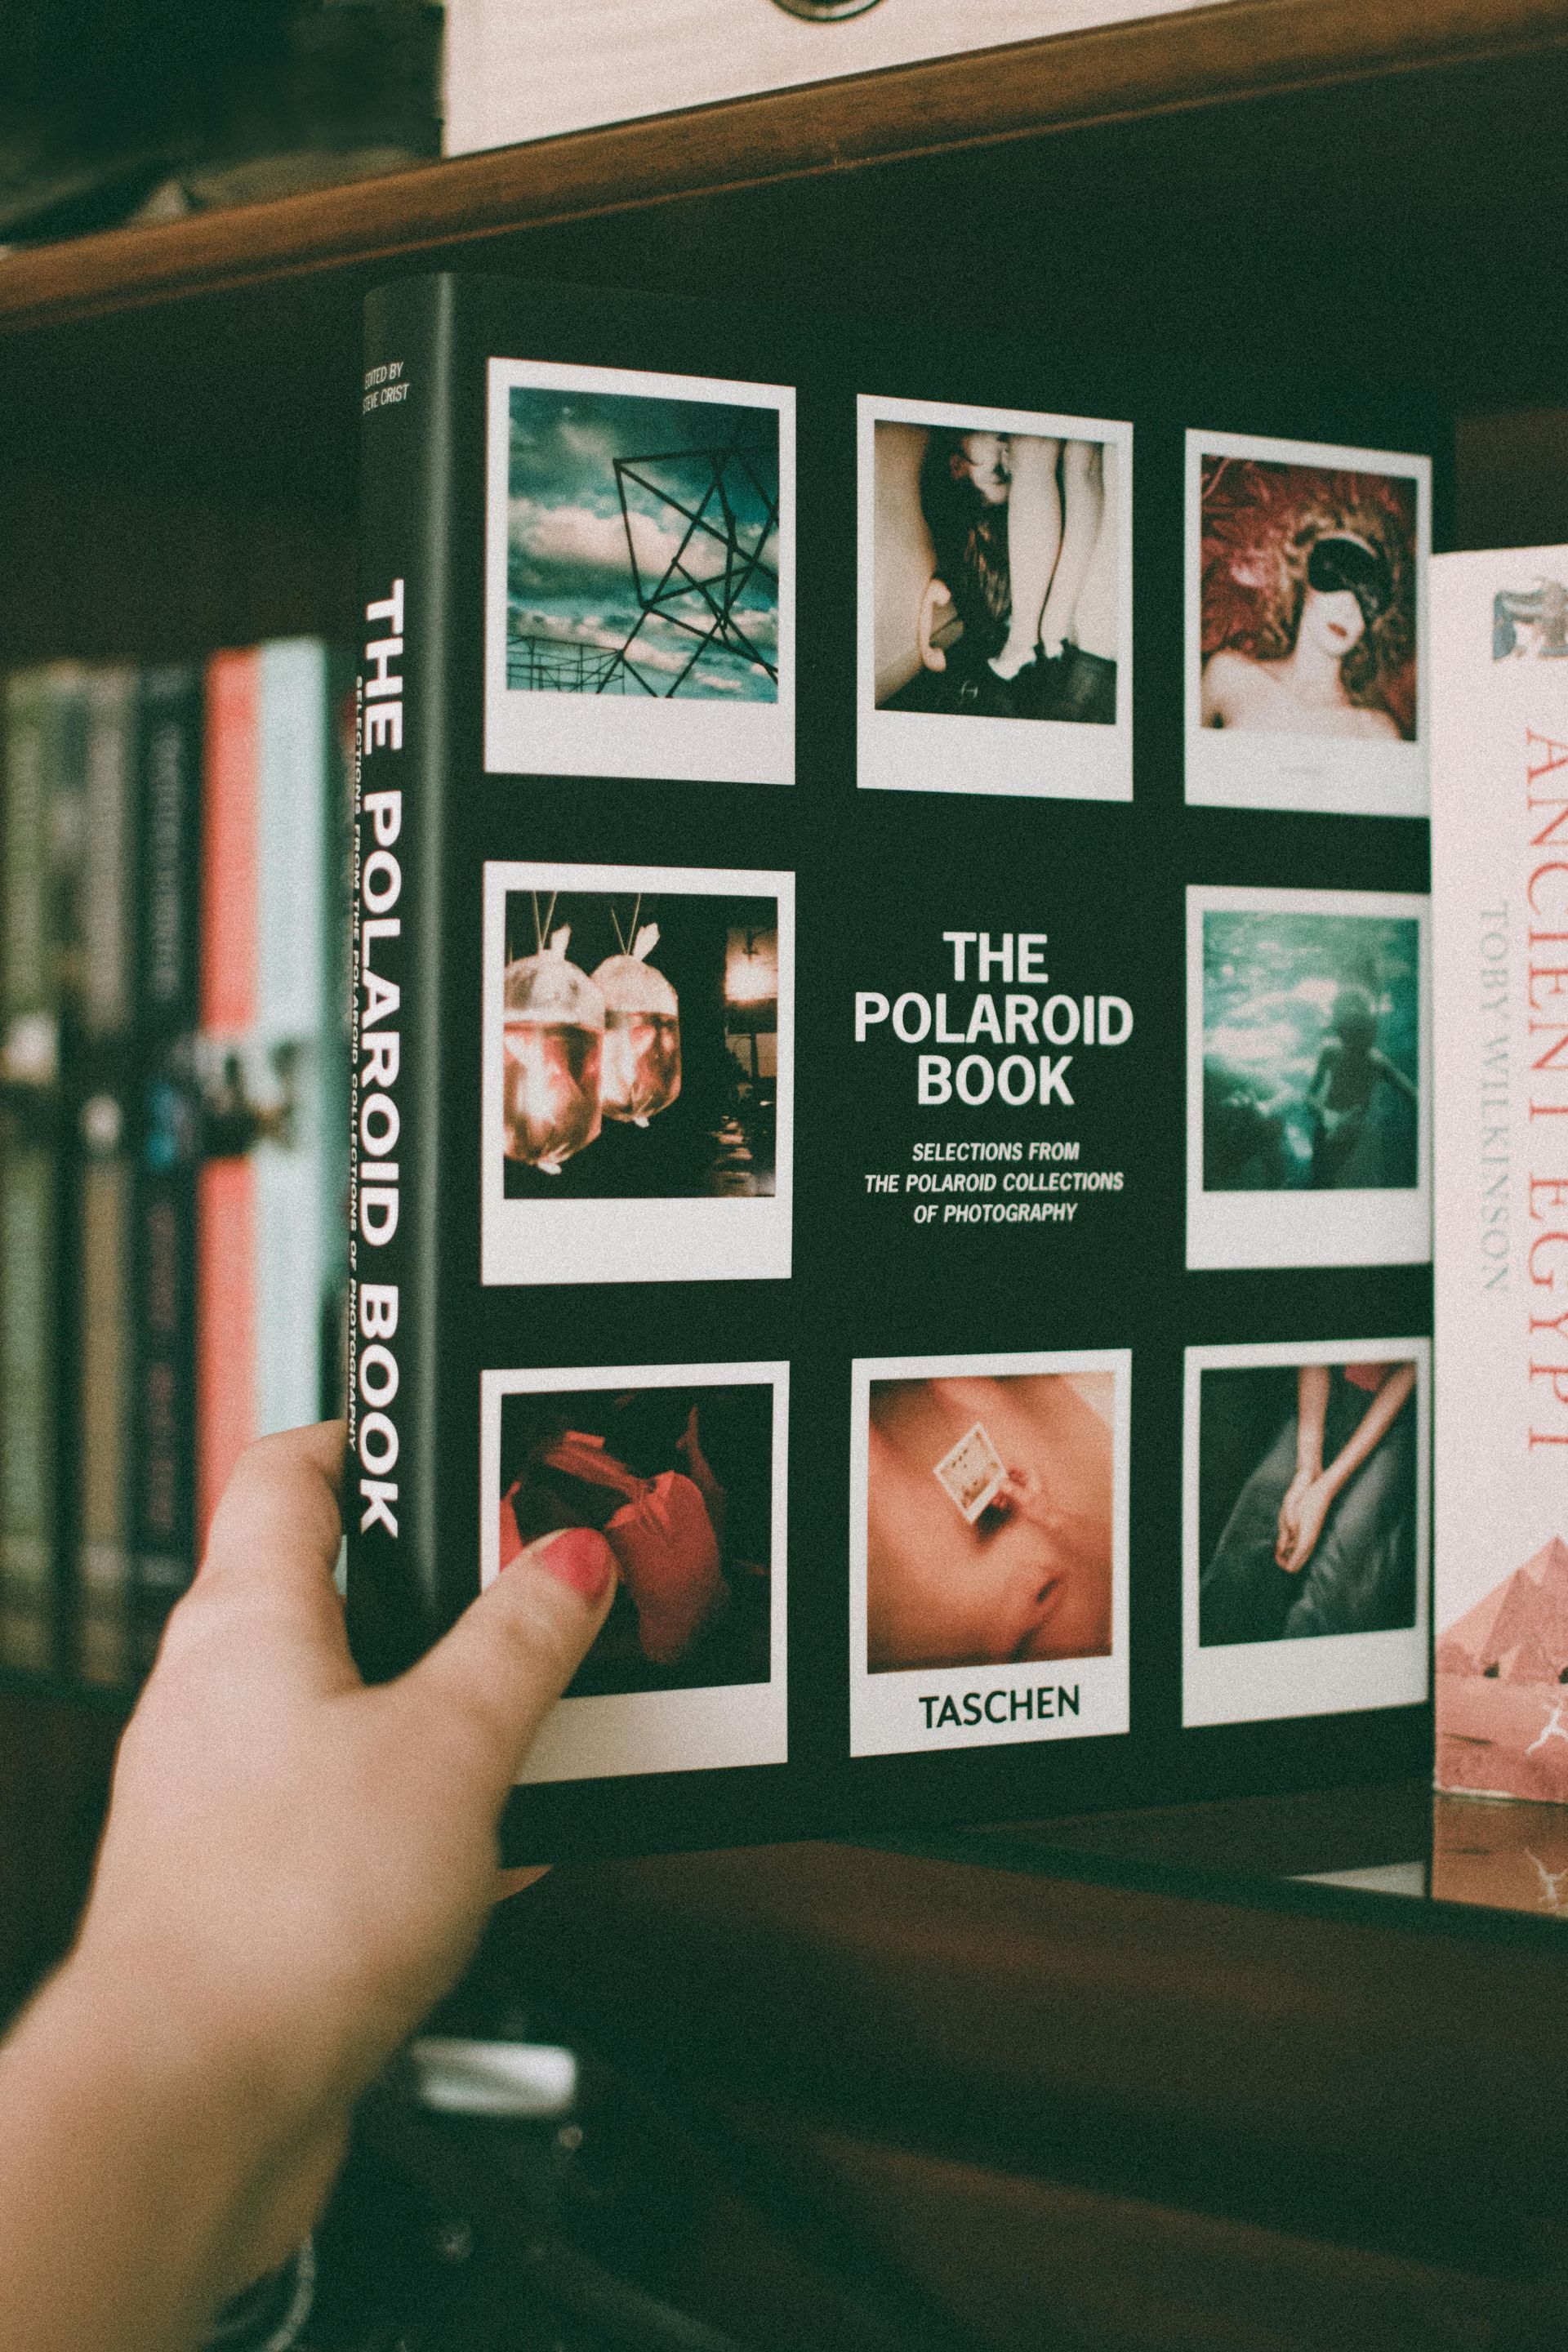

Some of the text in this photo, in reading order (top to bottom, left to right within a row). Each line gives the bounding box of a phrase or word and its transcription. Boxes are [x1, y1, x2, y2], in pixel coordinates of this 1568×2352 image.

[381, 382, 410, 405] CRIST
[389, 362, 403, 380] BY
[942, 931, 1049, 983] THE
[854, 991, 1134, 1046] POLAROID
[359, 578, 404, 1539] THE POLAROID BOOK
[917, 1054, 1076, 1106] BOOK
[1480, 900, 1511, 1294] TOBY WILKINSON
[912, 1142, 1080, 1161] SELECTIONS FROM
[865, 1171, 1125, 1193] THE POLAROID COLLECTIONS
[914, 1203, 1078, 1223] OF PHOTOGRAPHY
[919, 1684, 1080, 1729] TASCHEN
